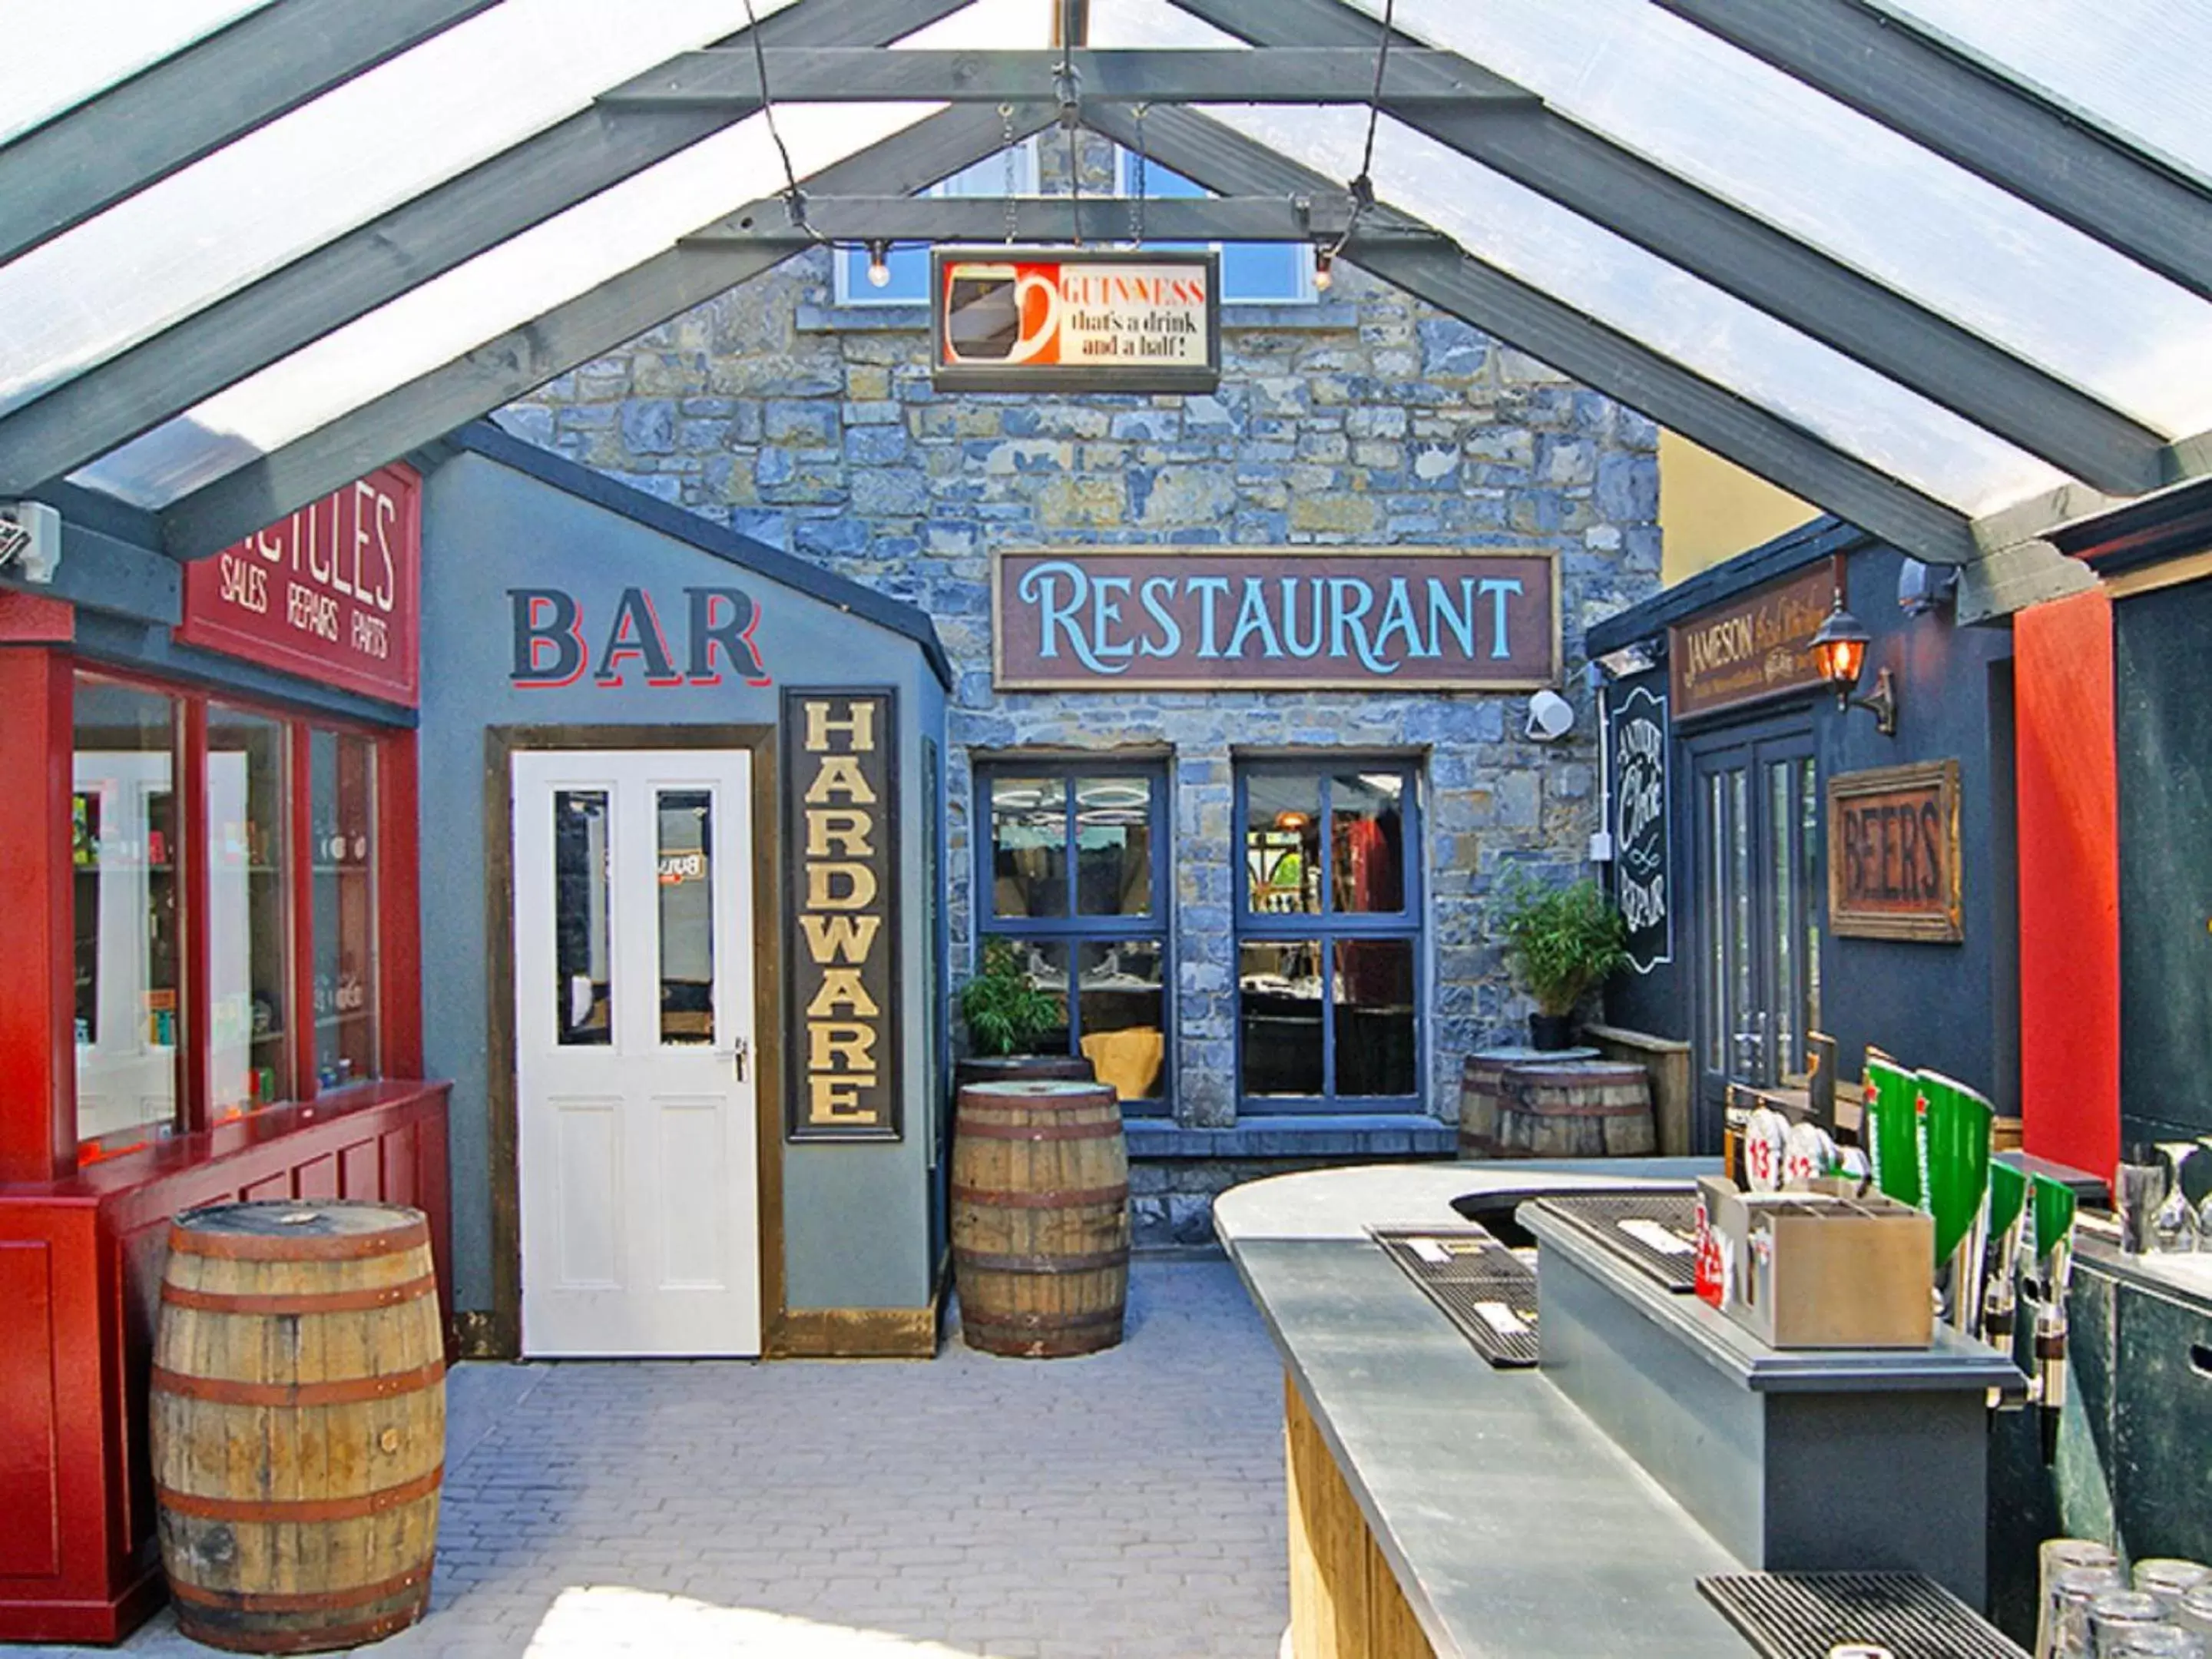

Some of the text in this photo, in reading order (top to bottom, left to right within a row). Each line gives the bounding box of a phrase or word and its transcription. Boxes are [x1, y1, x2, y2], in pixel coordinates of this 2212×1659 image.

[1061, 276, 1205, 306] GUINNESS
[1071, 310, 1197, 335] that's a drink
[1082, 336, 1118, 356] and
[1122, 340, 1135, 356] a
[220, 552, 389, 661] SALES REPAIRS PARTS
[506, 587, 772, 688] BAR
[1018, 561, 1525, 674] RESTAURANT
[1684, 613, 1755, 690] JAMESON
[1845, 802, 1940, 902] BEERS
[799, 700, 881, 1125] HARDWARE
[1749, 1137, 1770, 1181] 13
